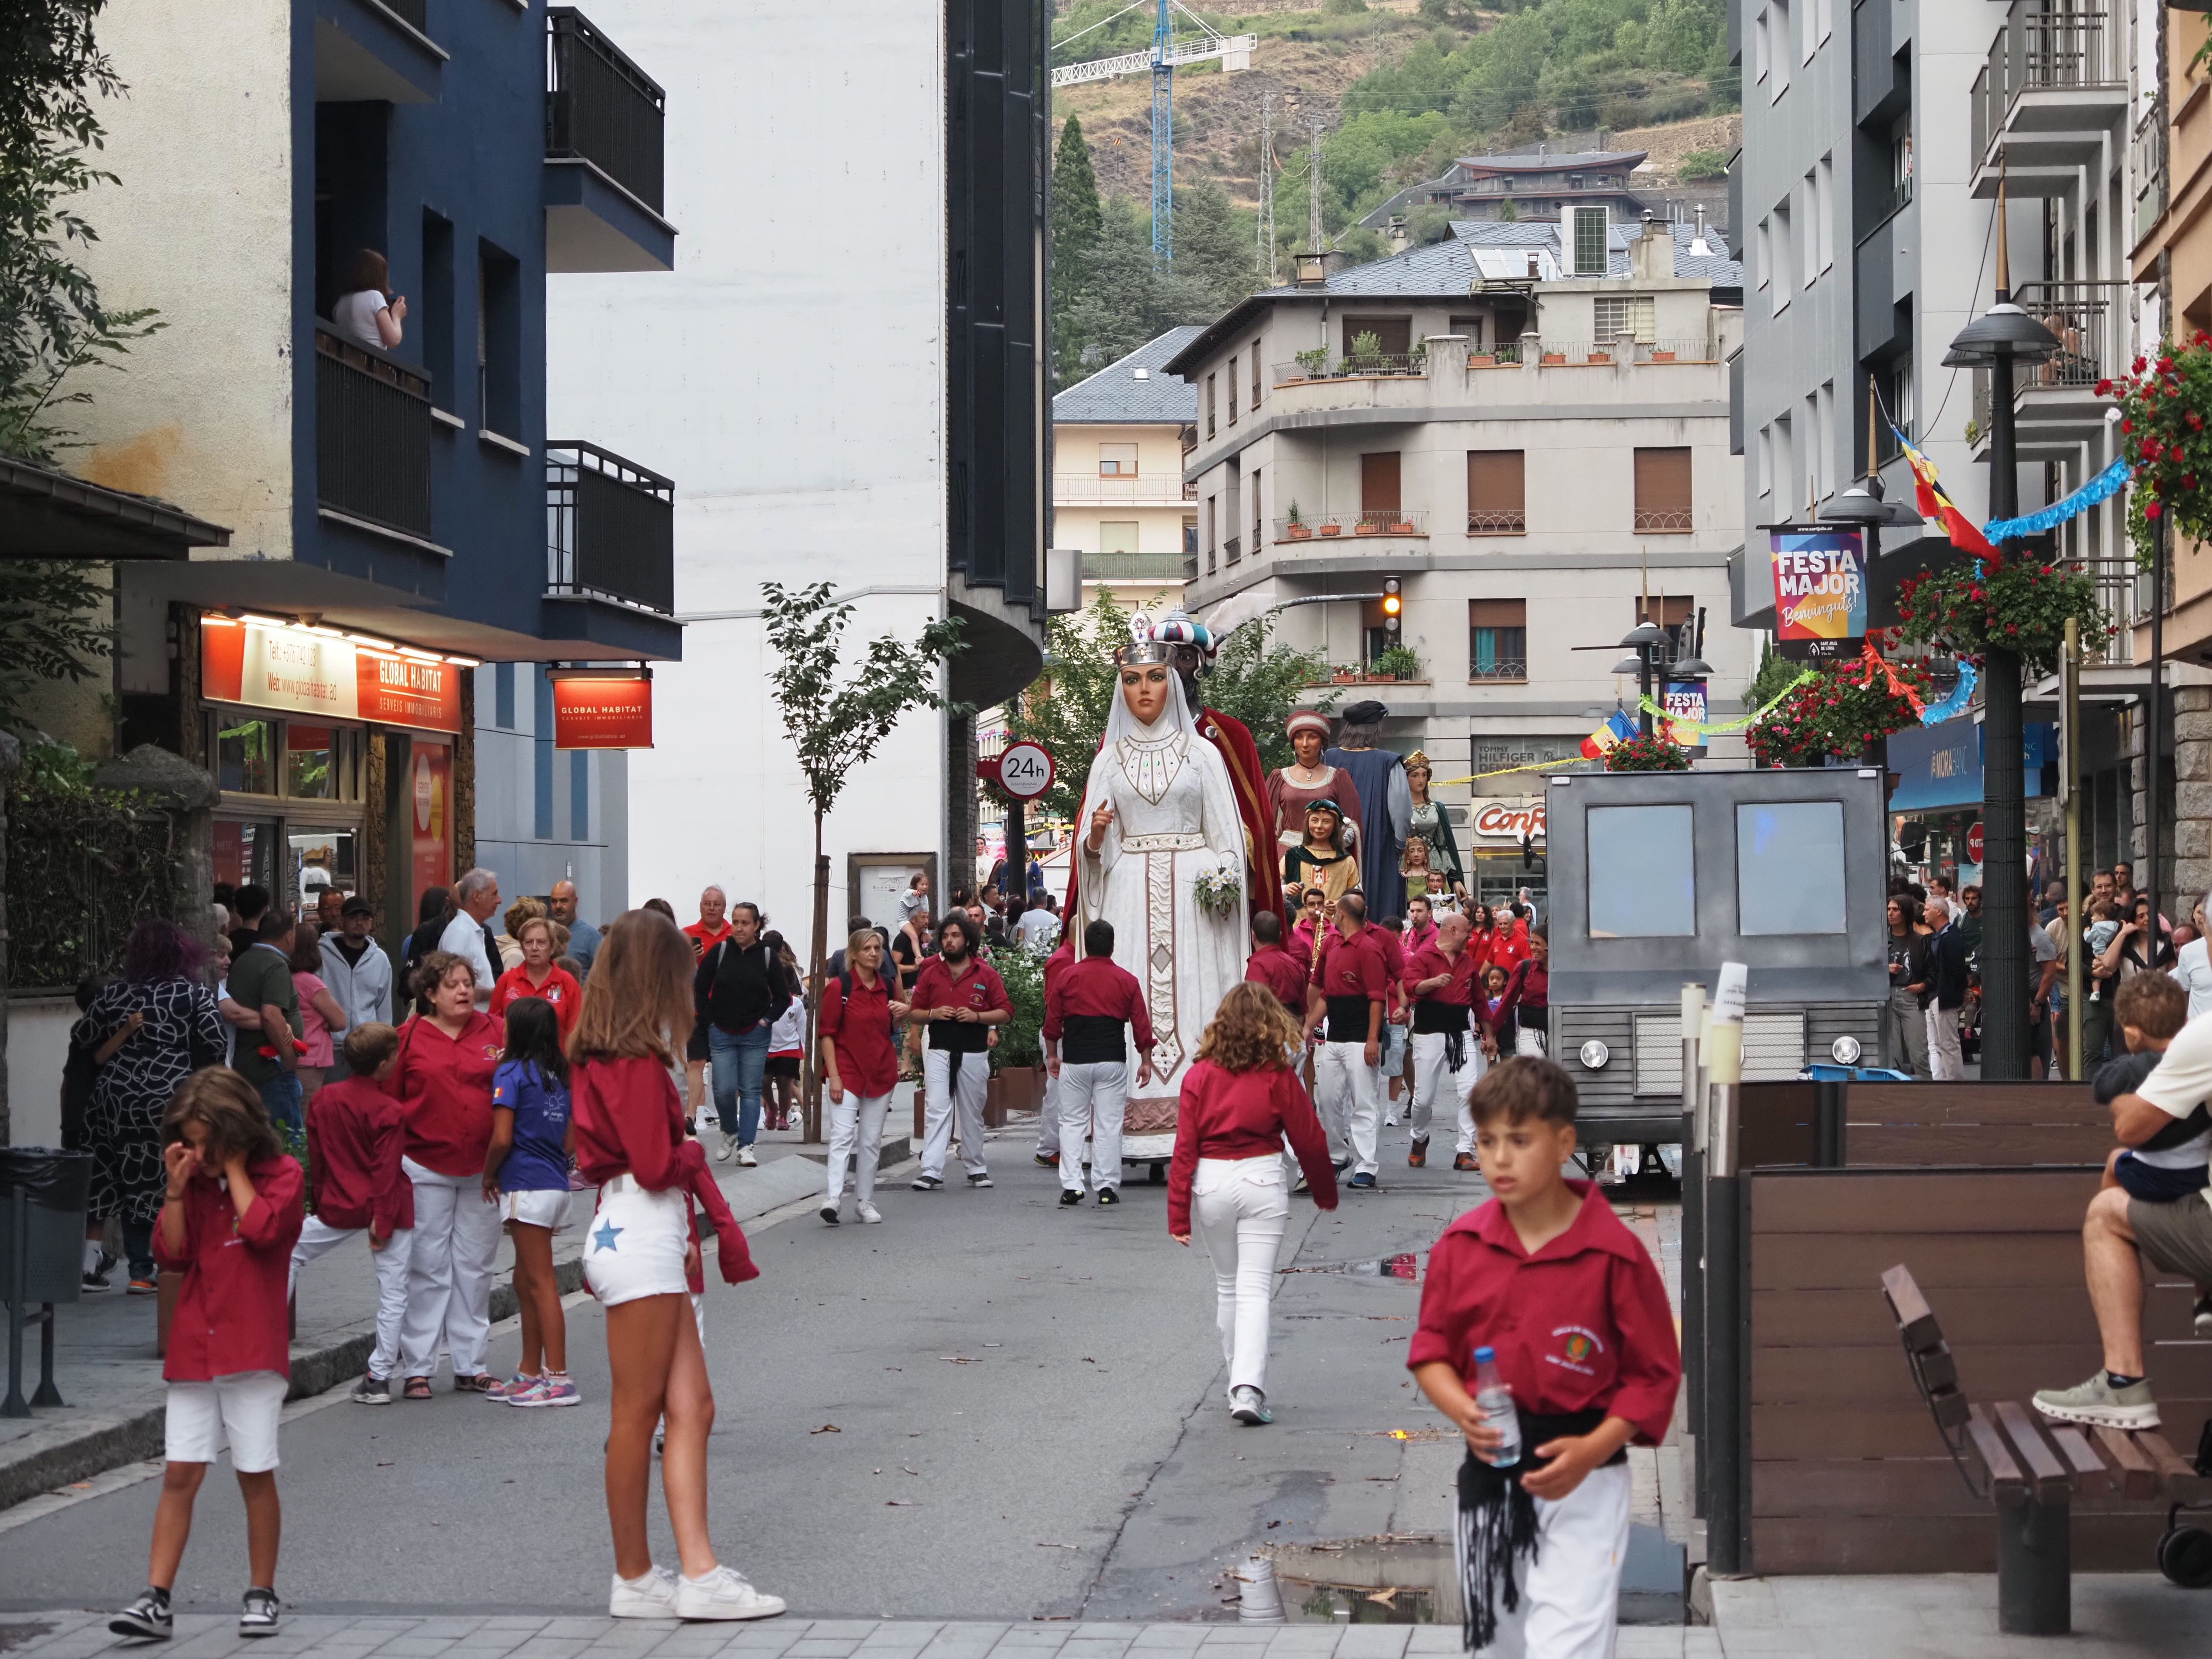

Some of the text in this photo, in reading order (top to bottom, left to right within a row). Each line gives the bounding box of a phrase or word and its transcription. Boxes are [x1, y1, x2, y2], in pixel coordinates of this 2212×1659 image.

[1778, 550, 1858, 574] FESTA
[1779, 573, 1860, 596] MAJOR
[1782, 592, 1857, 627] Benvinguts!
[268, 672, 281, 692] Web:
[379, 660, 442, 693] GLOBAL HABITAT
[379, 696, 442, 719] SERVEIS IMMOBILIARIS
[1666, 693, 1705, 707] FESTA
[1666, 707, 1706, 720] MAJOR
[1479, 753, 1534, 762] HILFIGER
[1007, 758, 1044, 778] 24h
[1479, 764, 1521, 773] DENIM
